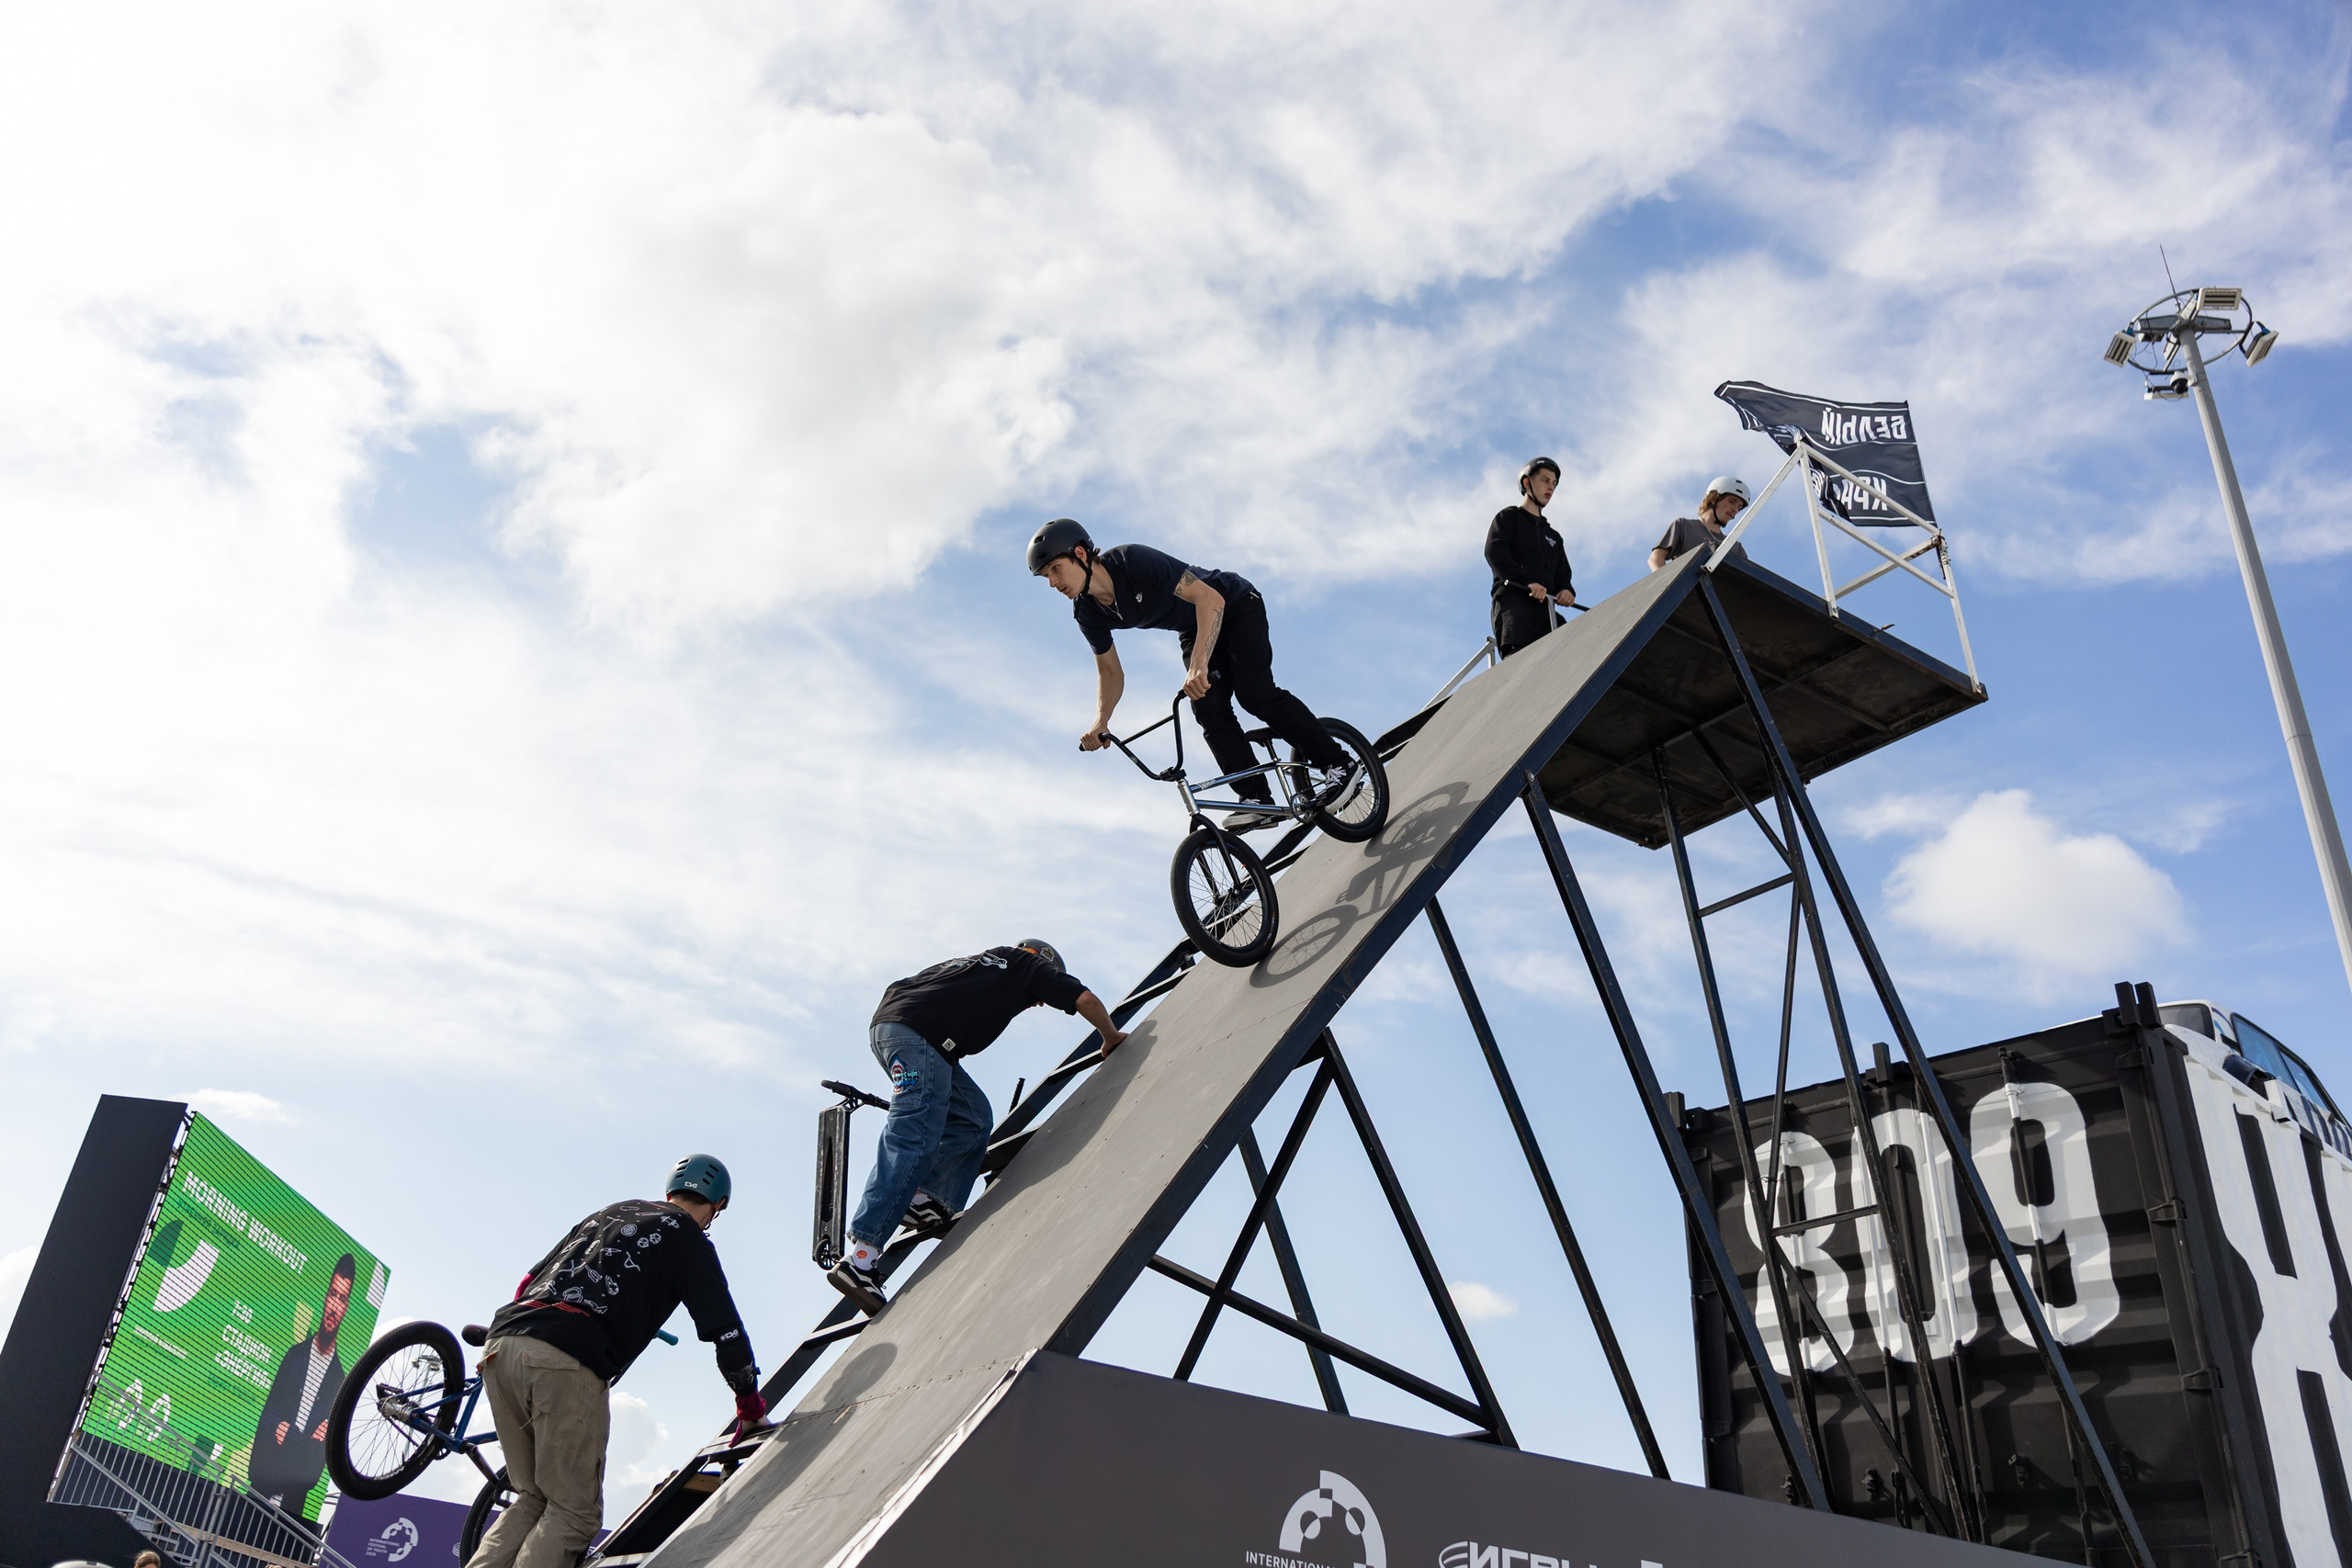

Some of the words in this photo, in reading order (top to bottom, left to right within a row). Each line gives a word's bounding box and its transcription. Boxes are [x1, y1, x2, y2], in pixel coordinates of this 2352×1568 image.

[183, 1170, 248, 1233] MORNING
[247, 1217, 308, 1275] WORKOUT
[1744, 1081, 2120, 1378] 809
[231, 1300, 253, 1324] 7:30
[221, 1324, 272, 1364] СТАДИОН
[214, 1349, 272, 1390] «ЭНЕРГИЯ»
